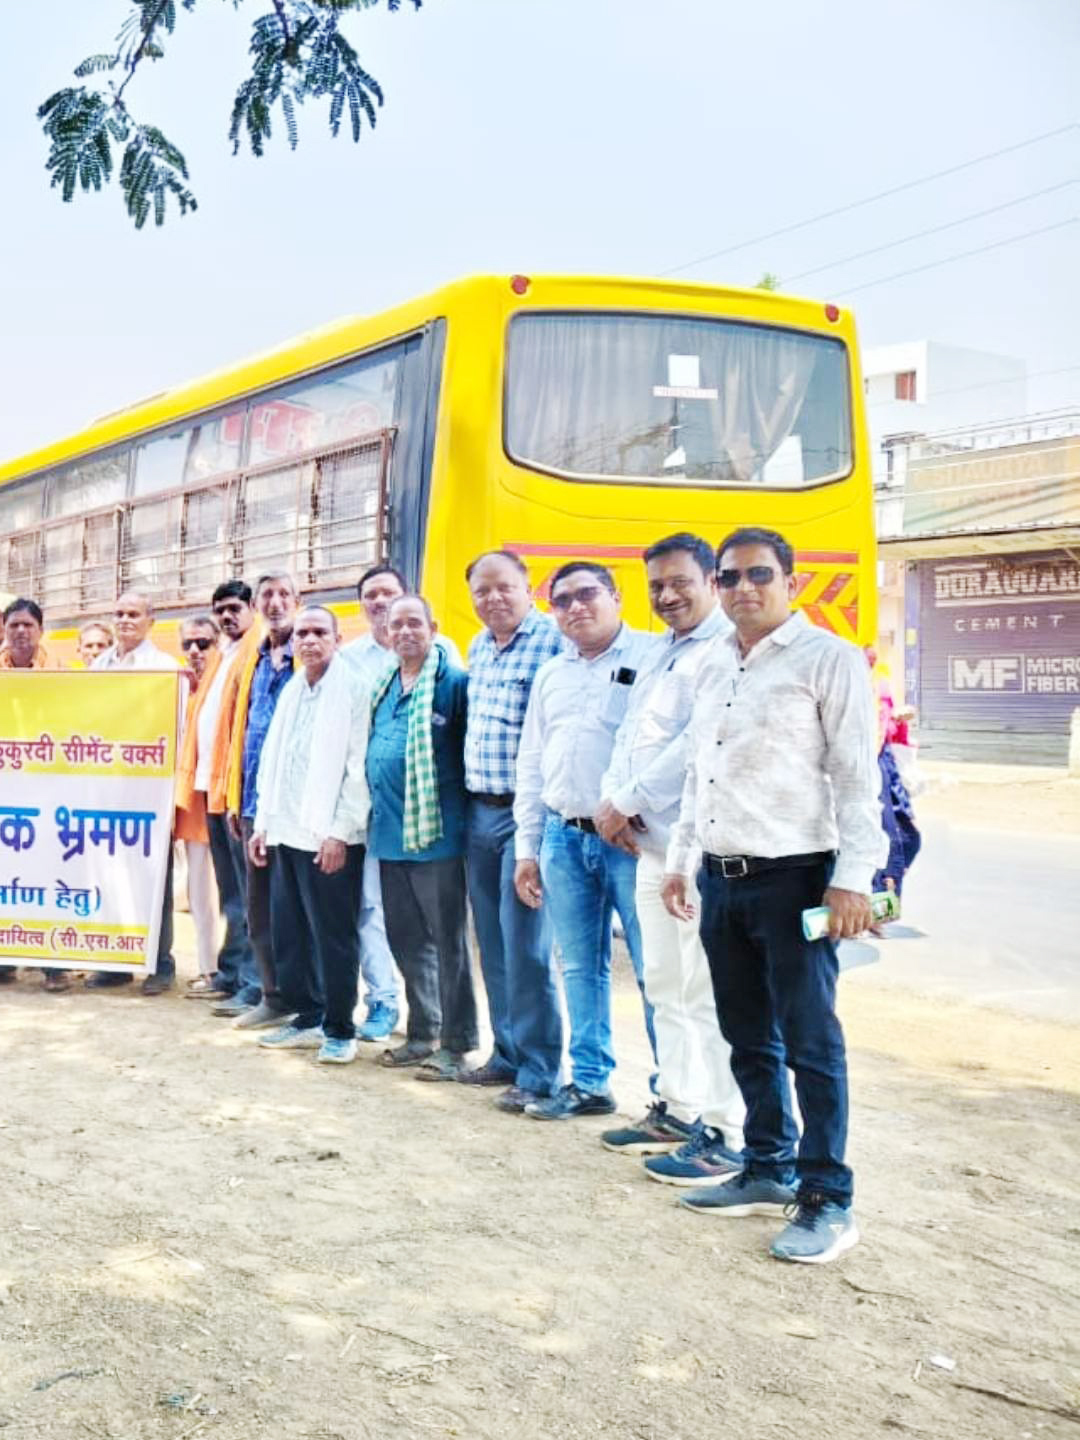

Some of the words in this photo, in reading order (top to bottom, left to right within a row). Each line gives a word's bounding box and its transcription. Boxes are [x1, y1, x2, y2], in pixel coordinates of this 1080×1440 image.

[953, 613, 1065, 633] CEMENT
[953, 658, 1019, 690] MF
[1026, 675, 1080, 693] FIBER
[63, 736, 114, 765] सीमेंट
[120, 736, 166, 766] वर्क्स
[54, 805, 157, 861] भ्रमण
[55, 880, 102, 917] हेतु)
